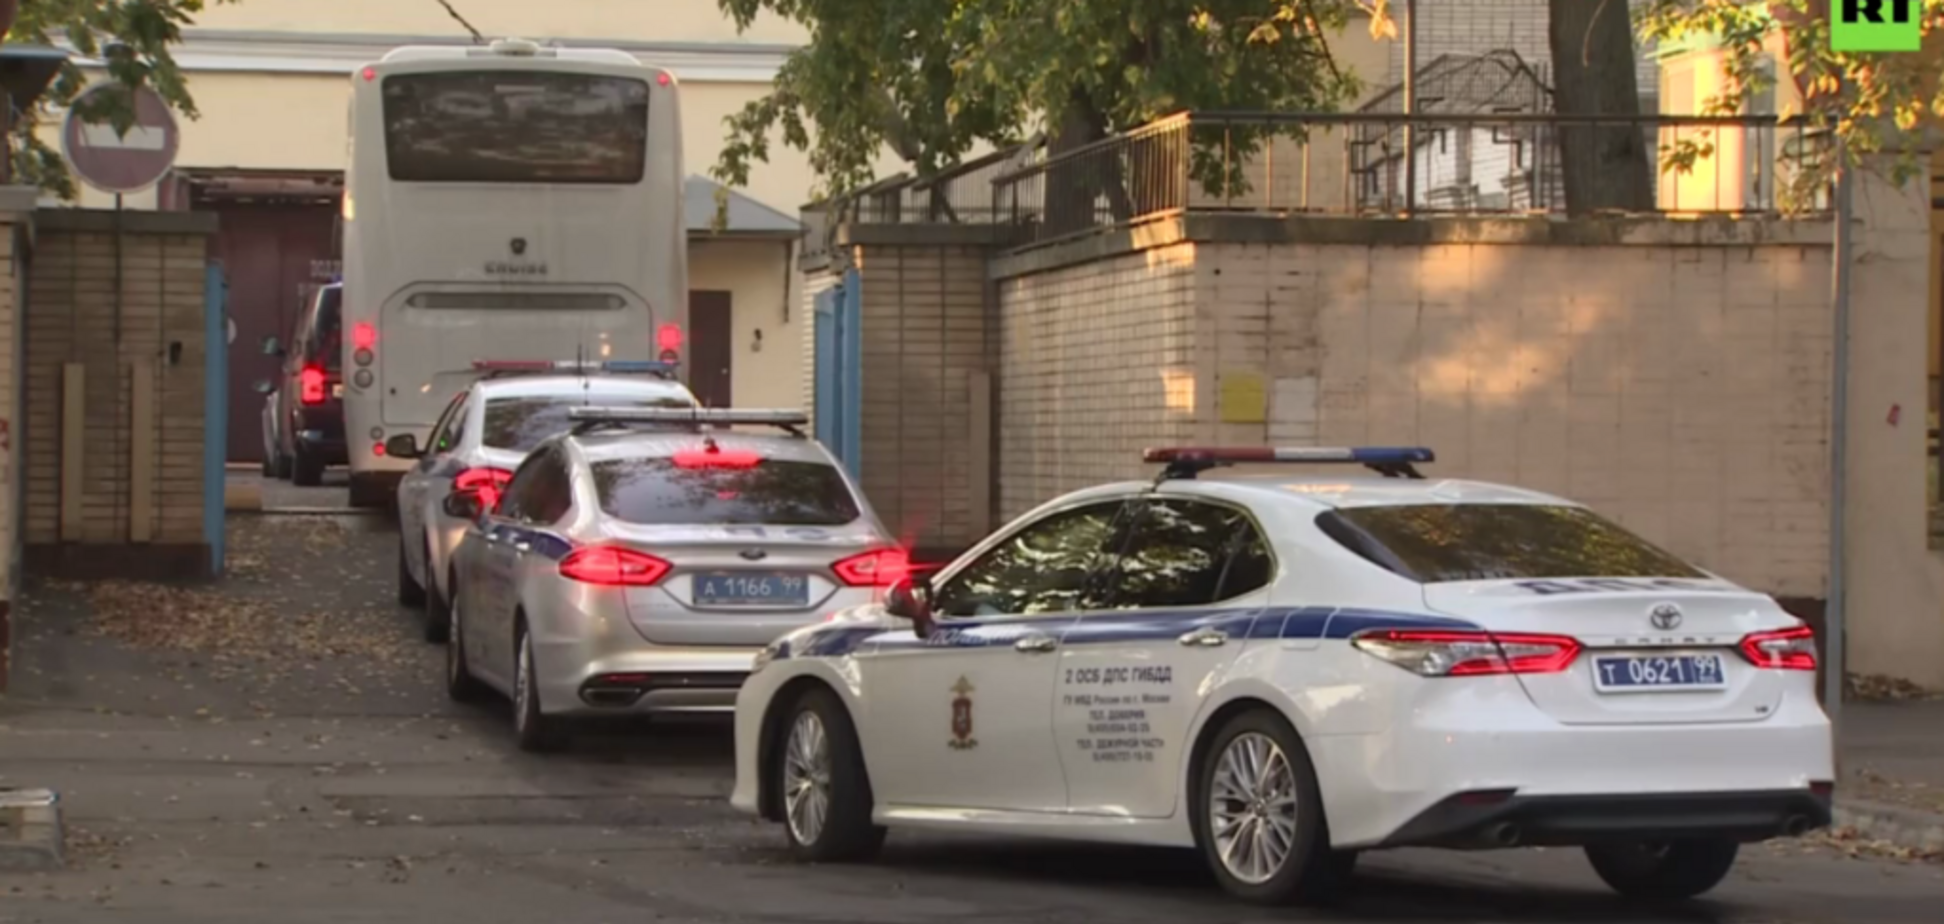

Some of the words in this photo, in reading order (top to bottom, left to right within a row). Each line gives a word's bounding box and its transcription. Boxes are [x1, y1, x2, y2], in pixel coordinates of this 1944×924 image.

[725, 576, 771, 596] 1166
[781, 576, 802, 593] 99
[1065, 668, 1073, 684] 2
[1076, 667, 1100, 684] ОСБ
[1103, 667, 1129, 685] ДПС
[1132, 665, 1172, 684] ГИБДД
[1628, 657, 1685, 683] 0621
[1694, 654, 1716, 675] 99
